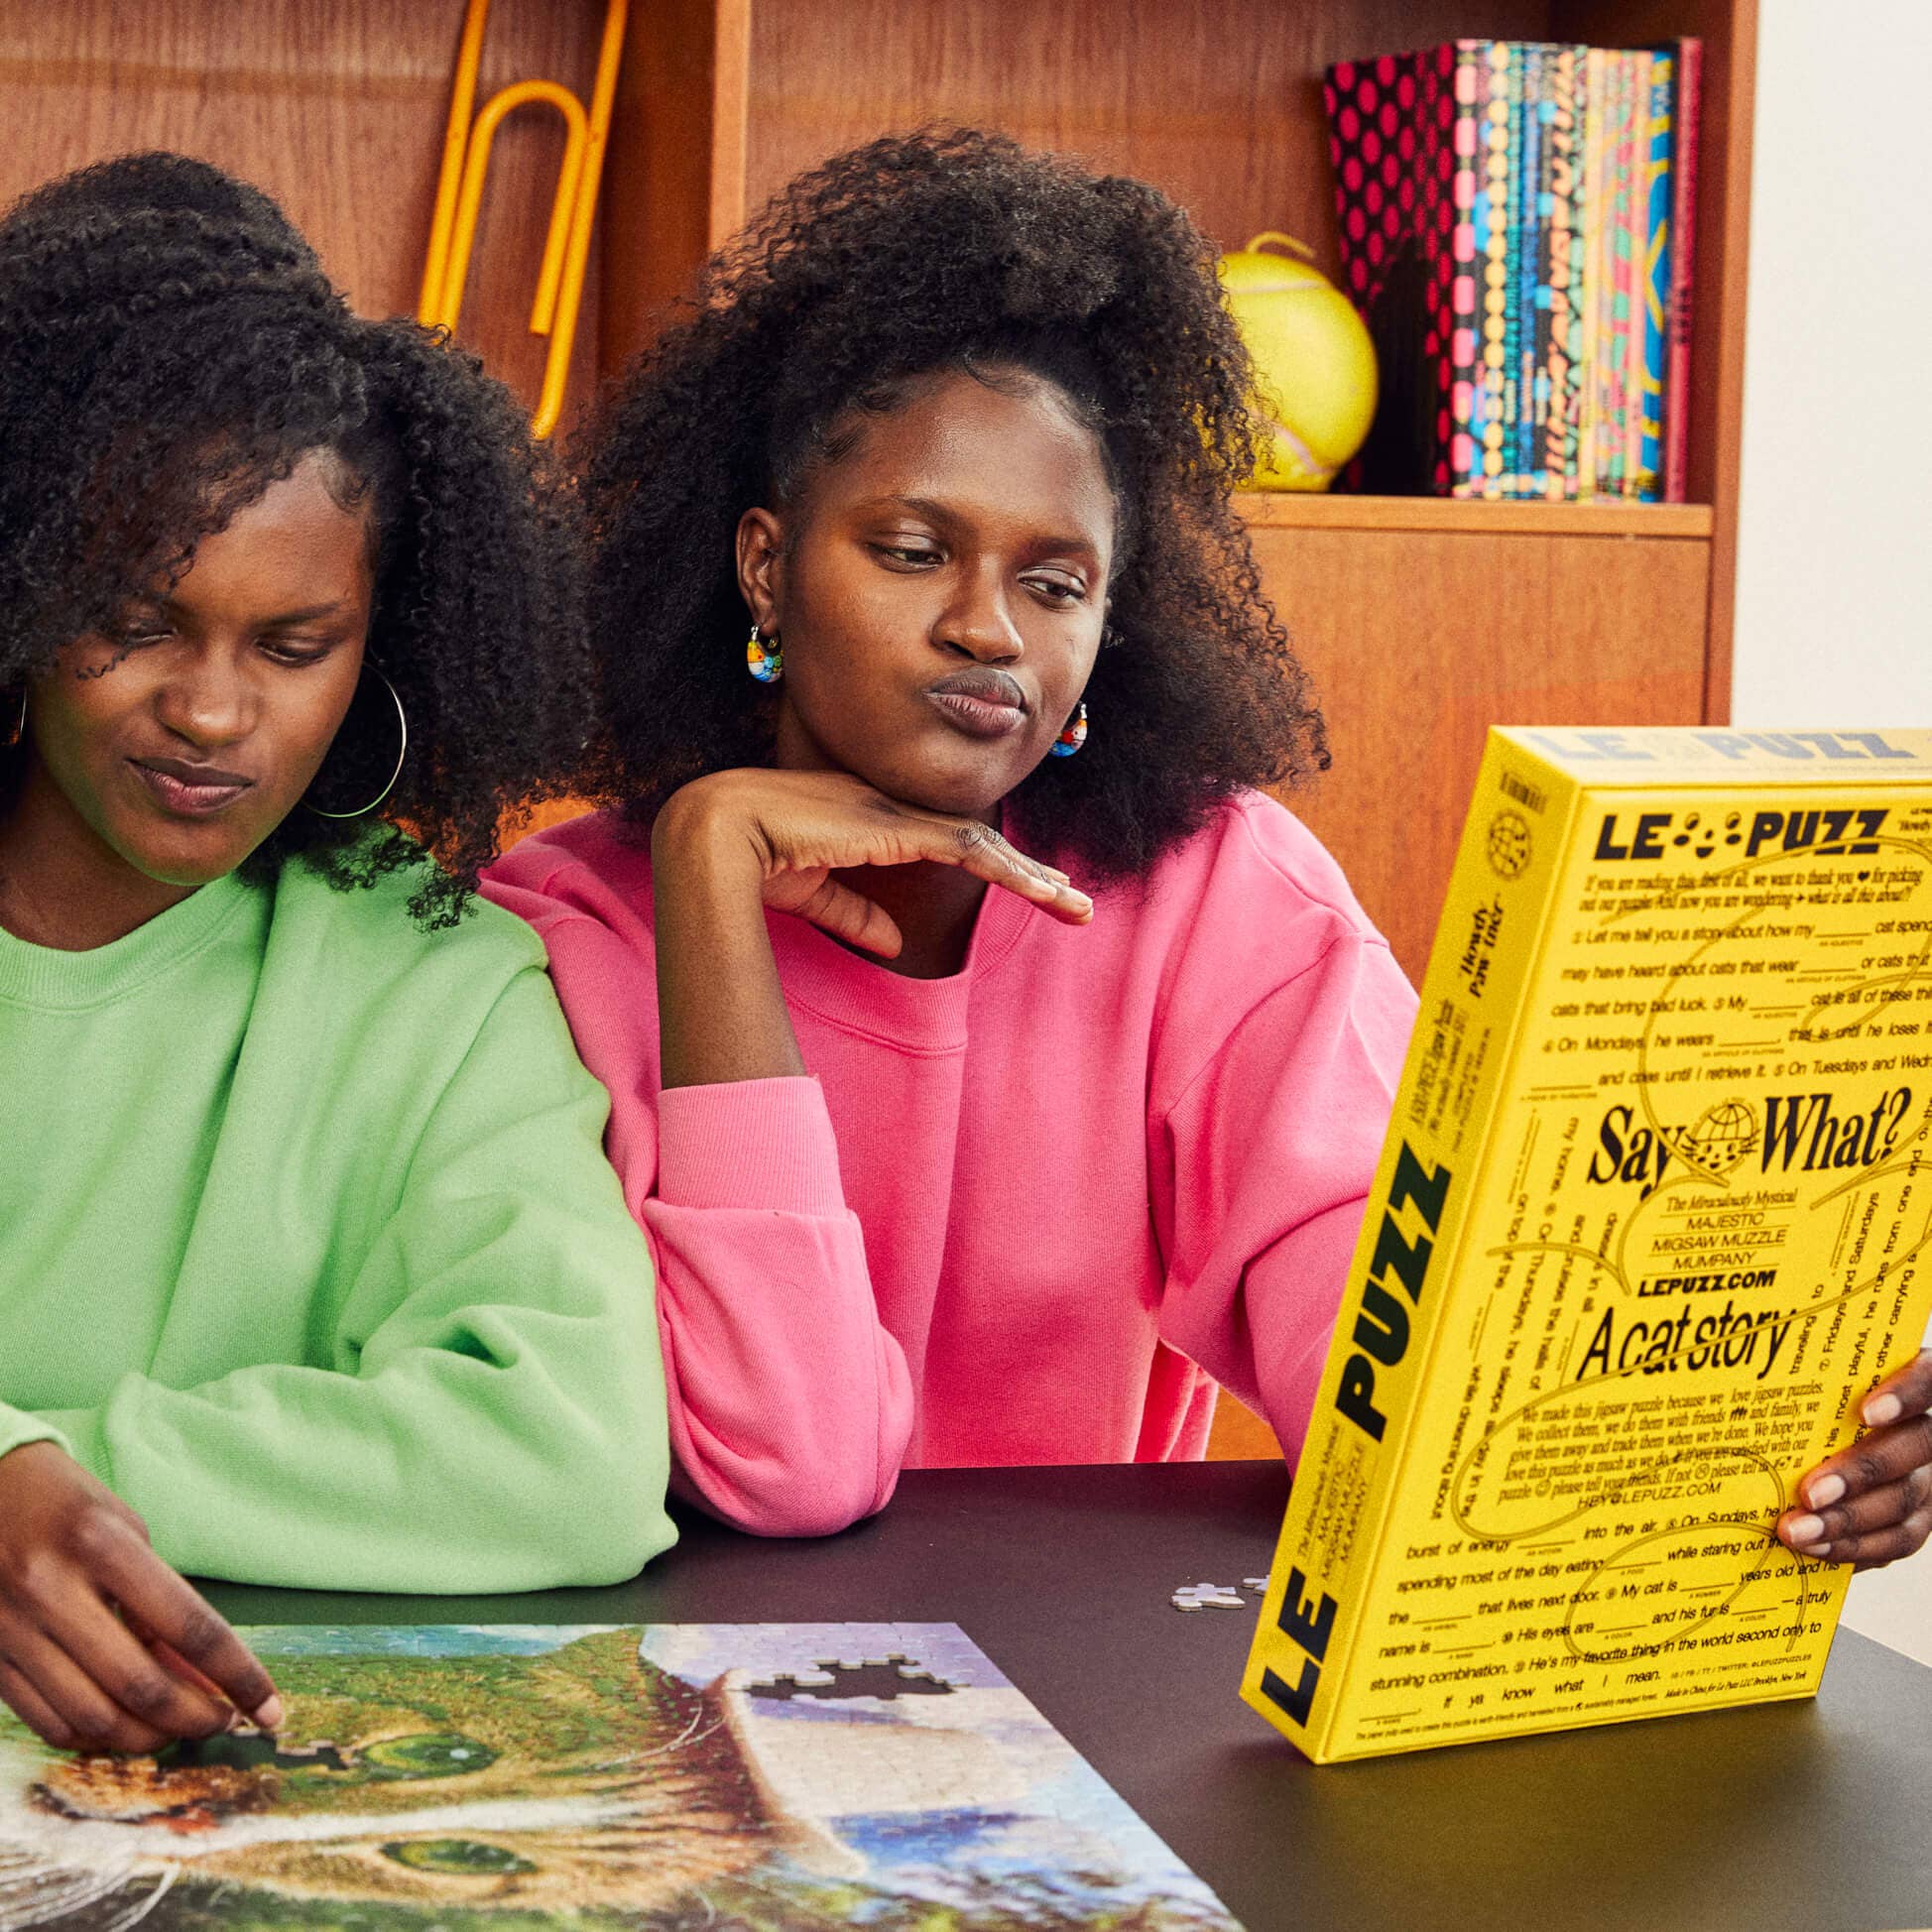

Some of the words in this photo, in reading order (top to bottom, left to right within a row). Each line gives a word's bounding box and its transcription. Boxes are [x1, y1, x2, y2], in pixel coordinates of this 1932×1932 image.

[1688, 732, 1919, 762] PUZZ
[1594, 813, 1673, 860] LE
[1745, 809, 1890, 857] PUZZ
[1764, 923, 1791, 938] how
[1793, 924, 1816, 941] my
[1813, 1057, 1869, 1076] Tuesdays
[1871, 1055, 1897, 1071] and
[1586, 1105, 1687, 1202] Say
[1760, 1086, 1912, 1174] What?
[1651, 1233, 1720, 1254] MIGSAW
[1721, 1228, 1787, 1249] MUZZLE
[1686, 1212, 1765, 1231] MAJESTIC
[1636, 1269, 1777, 1298] LEPUZZ.COM
[1671, 1251, 1757, 1271] MUMPANY
[1823, 1301, 1848, 1354] Fridays
[1849, 1190, 1880, 1266] Saturdays
[1334, 1138, 1453, 1445] PUZZ
[1834, 1384, 1854, 1420] most
[1862, 1299, 1878, 1320] he
[1882, 1219, 1902, 1256] from
[1895, 1183, 1913, 1214] one
[1874, 1331, 1894, 1369] other
[1887, 1268, 1915, 1327] carrying
[1575, 1306, 1615, 1382] A
[1686, 1300, 1797, 1381] story
[1788, 1314, 1818, 1376] traveling
[1405, 1540, 1442, 1561] burst
[1446, 1538, 1463, 1555] of
[1583, 1525, 1608, 1541] into
[1614, 1522, 1635, 1538] the
[1680, 1513, 1700, 1528] On
[1763, 1503, 1781, 1518] he
[1388, 1611, 1411, 1627] the
[1476, 1600, 1505, 1617] that
[1505, 1597, 1535, 1614] lives
[1537, 1593, 1567, 1610] next
[1620, 1583, 1642, 1603] My
[1642, 1579, 1664, 1597] cat
[1666, 1577, 1678, 1594] is
[1739, 1564, 1773, 1586] years
[1774, 1561, 1796, 1579] old
[1796, 1558, 1821, 1577] and
[1395, 1573, 1458, 1596] spending
[1460, 1568, 1494, 1587] most
[1496, 1566, 1513, 1583] of
[1512, 1564, 1536, 1581] the
[1537, 1561, 1564, 1580] day
[1666, 1543, 1698, 1562] while
[1699, 1539, 1742, 1560] staring
[1743, 1537, 1765, 1554] out
[1259, 1564, 1339, 1731] LE
[1378, 1642, 1417, 1659] name
[1516, 1627, 1539, 1643] His
[1650, 1609, 1677, 1628] and
[1677, 1607, 1698, 1625] his
[1804, 1589, 1834, 1606] truly
[1369, 1671, 1426, 1692] stunning
[1526, 1654, 1558, 1672] He's
[1676, 1636, 1699, 1653] the
[1700, 1631, 1735, 1650] world
[1735, 1626, 1781, 1646] second
[1808, 1621, 1823, 1636] to
[1501, 1686, 1536, 1702] know
[1553, 1678, 1587, 1695] what
